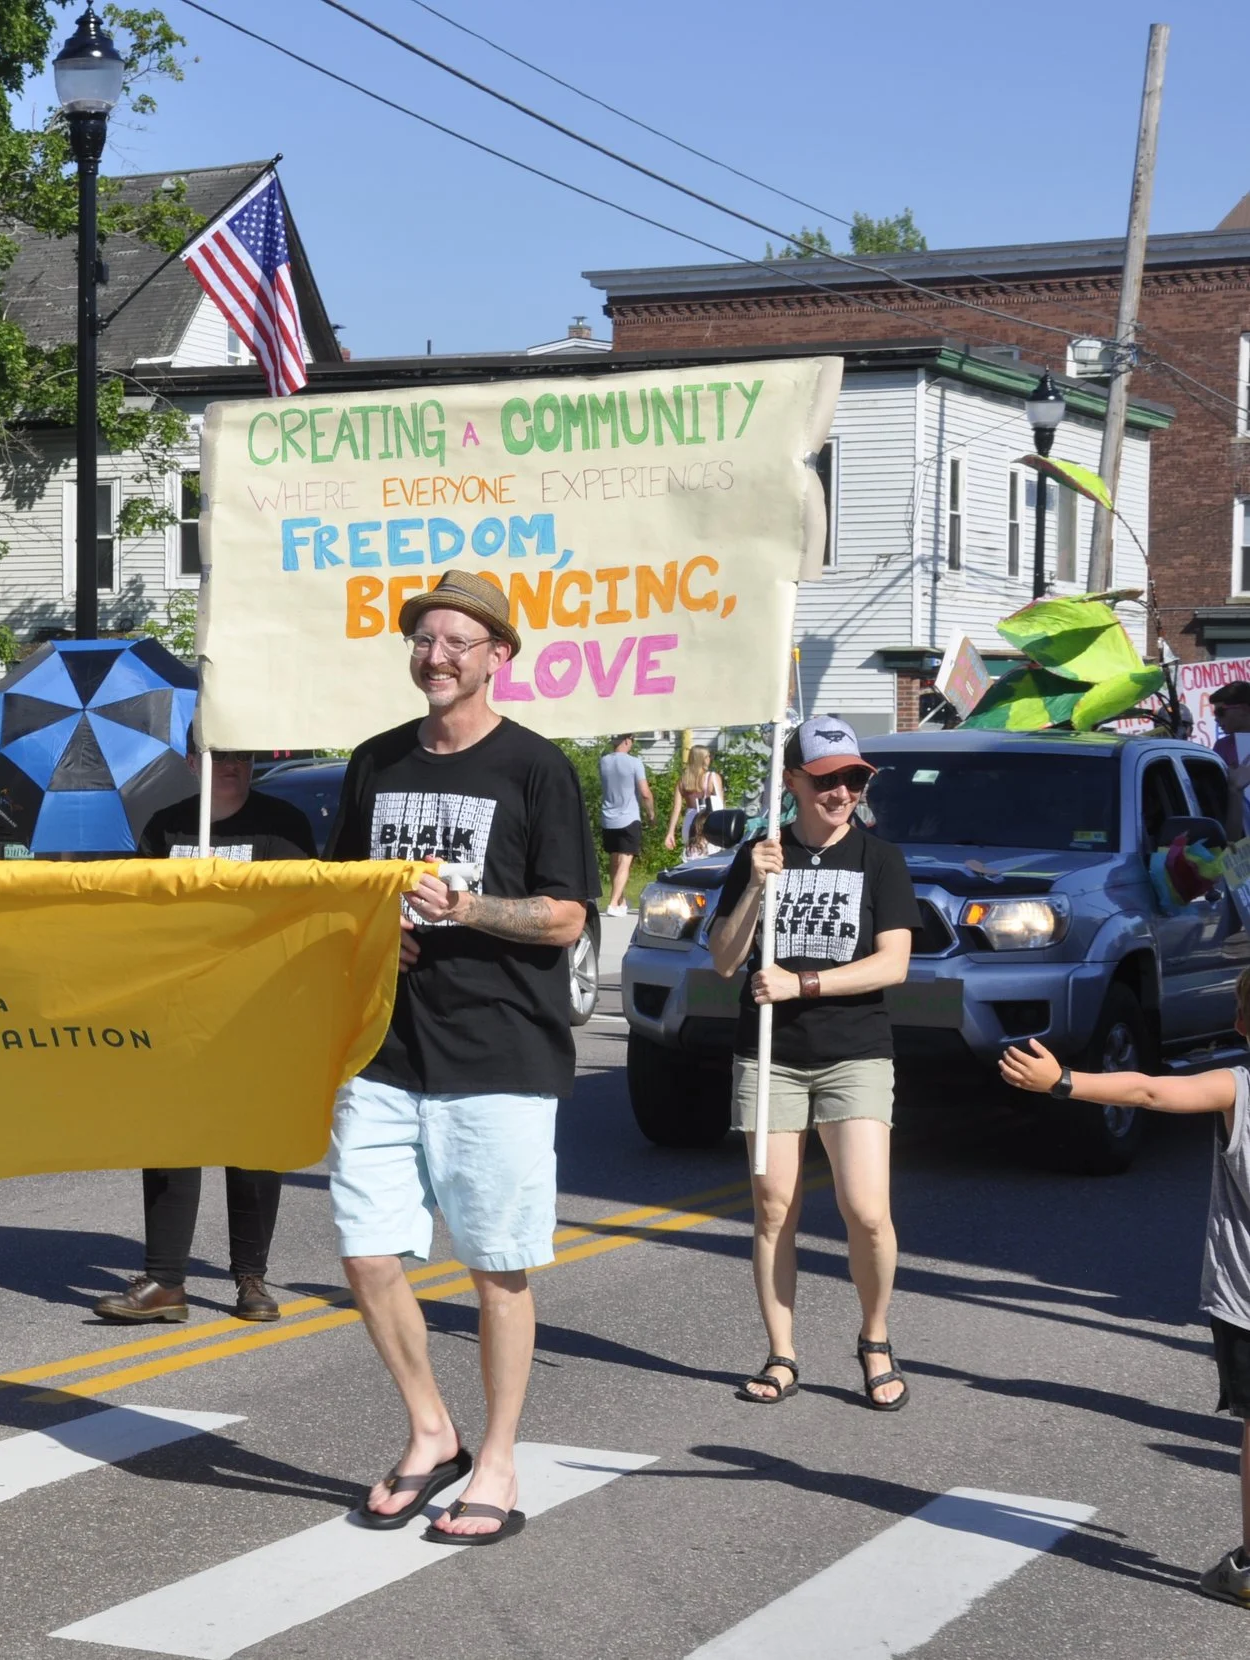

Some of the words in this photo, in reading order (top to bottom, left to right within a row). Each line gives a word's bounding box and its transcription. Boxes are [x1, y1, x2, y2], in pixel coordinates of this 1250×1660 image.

[249, 400, 446, 467] CREATING
[462, 421, 480, 447] A
[501, 380, 764, 455] COMMUNITY
[248, 480, 359, 512] WHERE
[383, 474, 517, 507] EVERYONE
[542, 460, 735, 503] EXPERIENCES
[282, 513, 574, 572] FREEDOM,
[493, 634, 679, 702] LOVE
[380, 824, 475, 850] BLACK
[776, 891, 850, 905] LACK
[778, 906, 841, 920] IVES
[775, 919, 856, 939] ATTER
